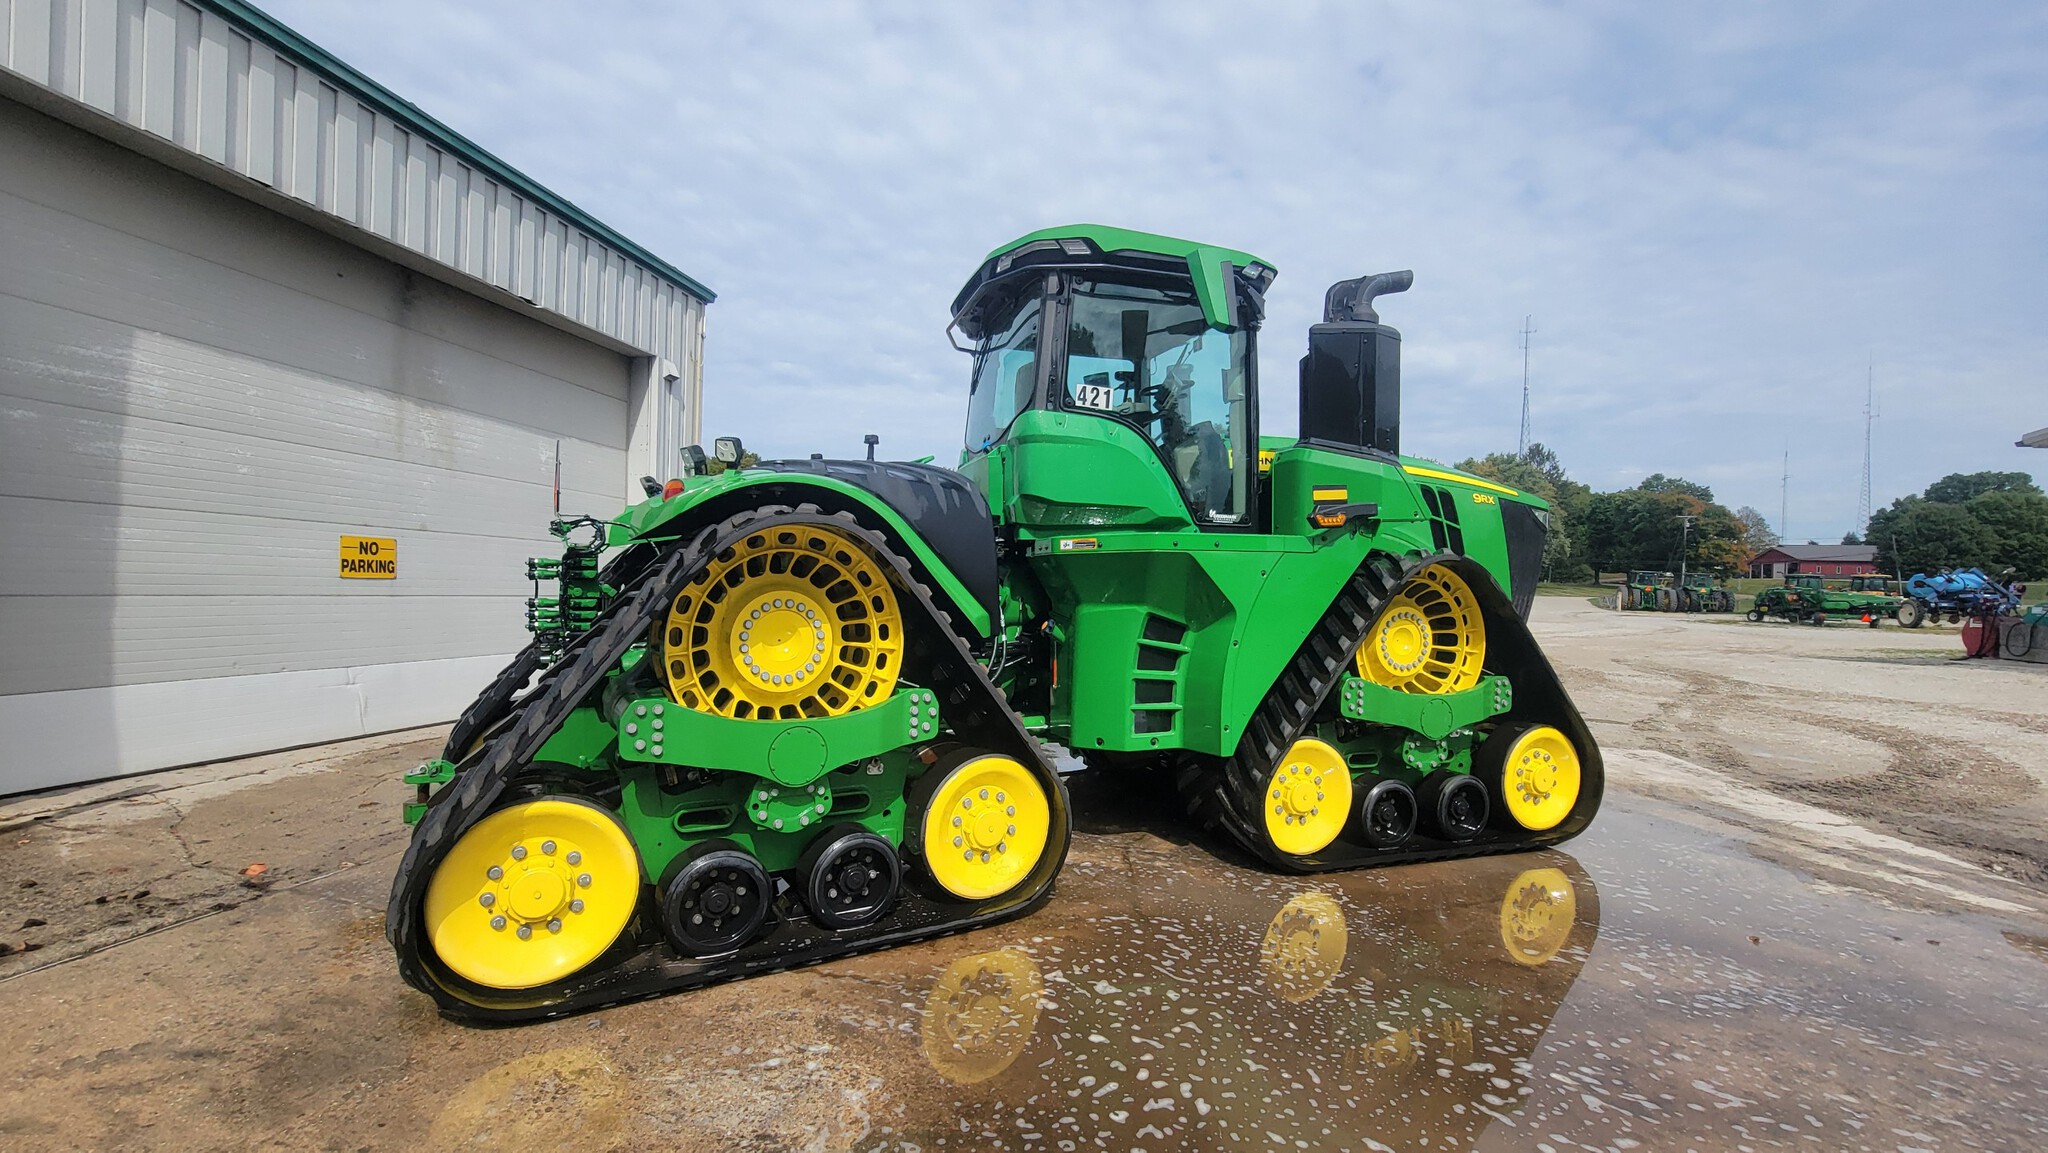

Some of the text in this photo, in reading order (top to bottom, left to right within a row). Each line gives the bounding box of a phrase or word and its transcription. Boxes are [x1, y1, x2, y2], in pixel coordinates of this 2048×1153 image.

[1077, 385, 1111, 409] 421
[1472, 493, 1496, 505] 9RX
[359, 541, 379, 556] NO
[341, 558, 395, 574] PARKING
